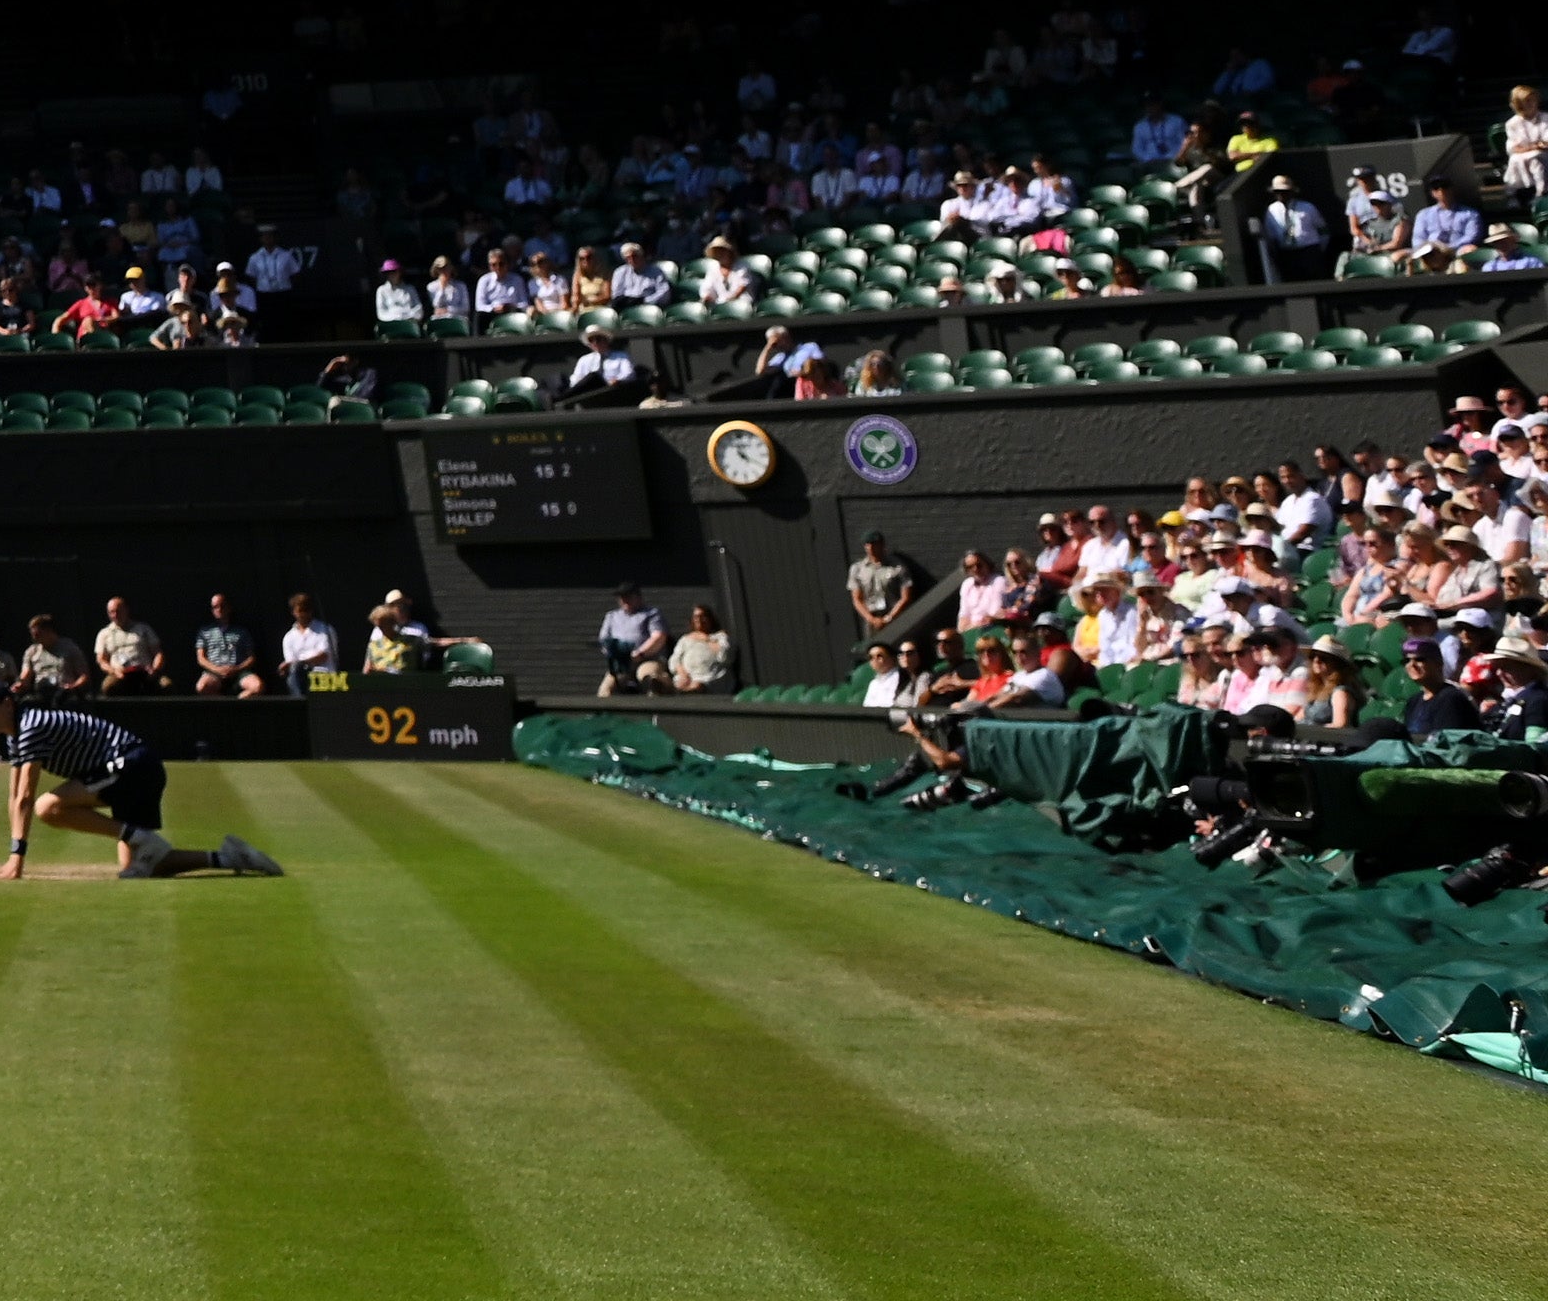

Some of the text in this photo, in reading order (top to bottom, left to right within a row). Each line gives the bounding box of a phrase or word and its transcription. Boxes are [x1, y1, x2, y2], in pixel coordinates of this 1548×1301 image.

[445, 512, 495, 527] HALEP
[308, 671, 350, 692] IBM
[448, 676, 505, 687] JAGUAR
[366, 706, 479, 750] 92 mph
